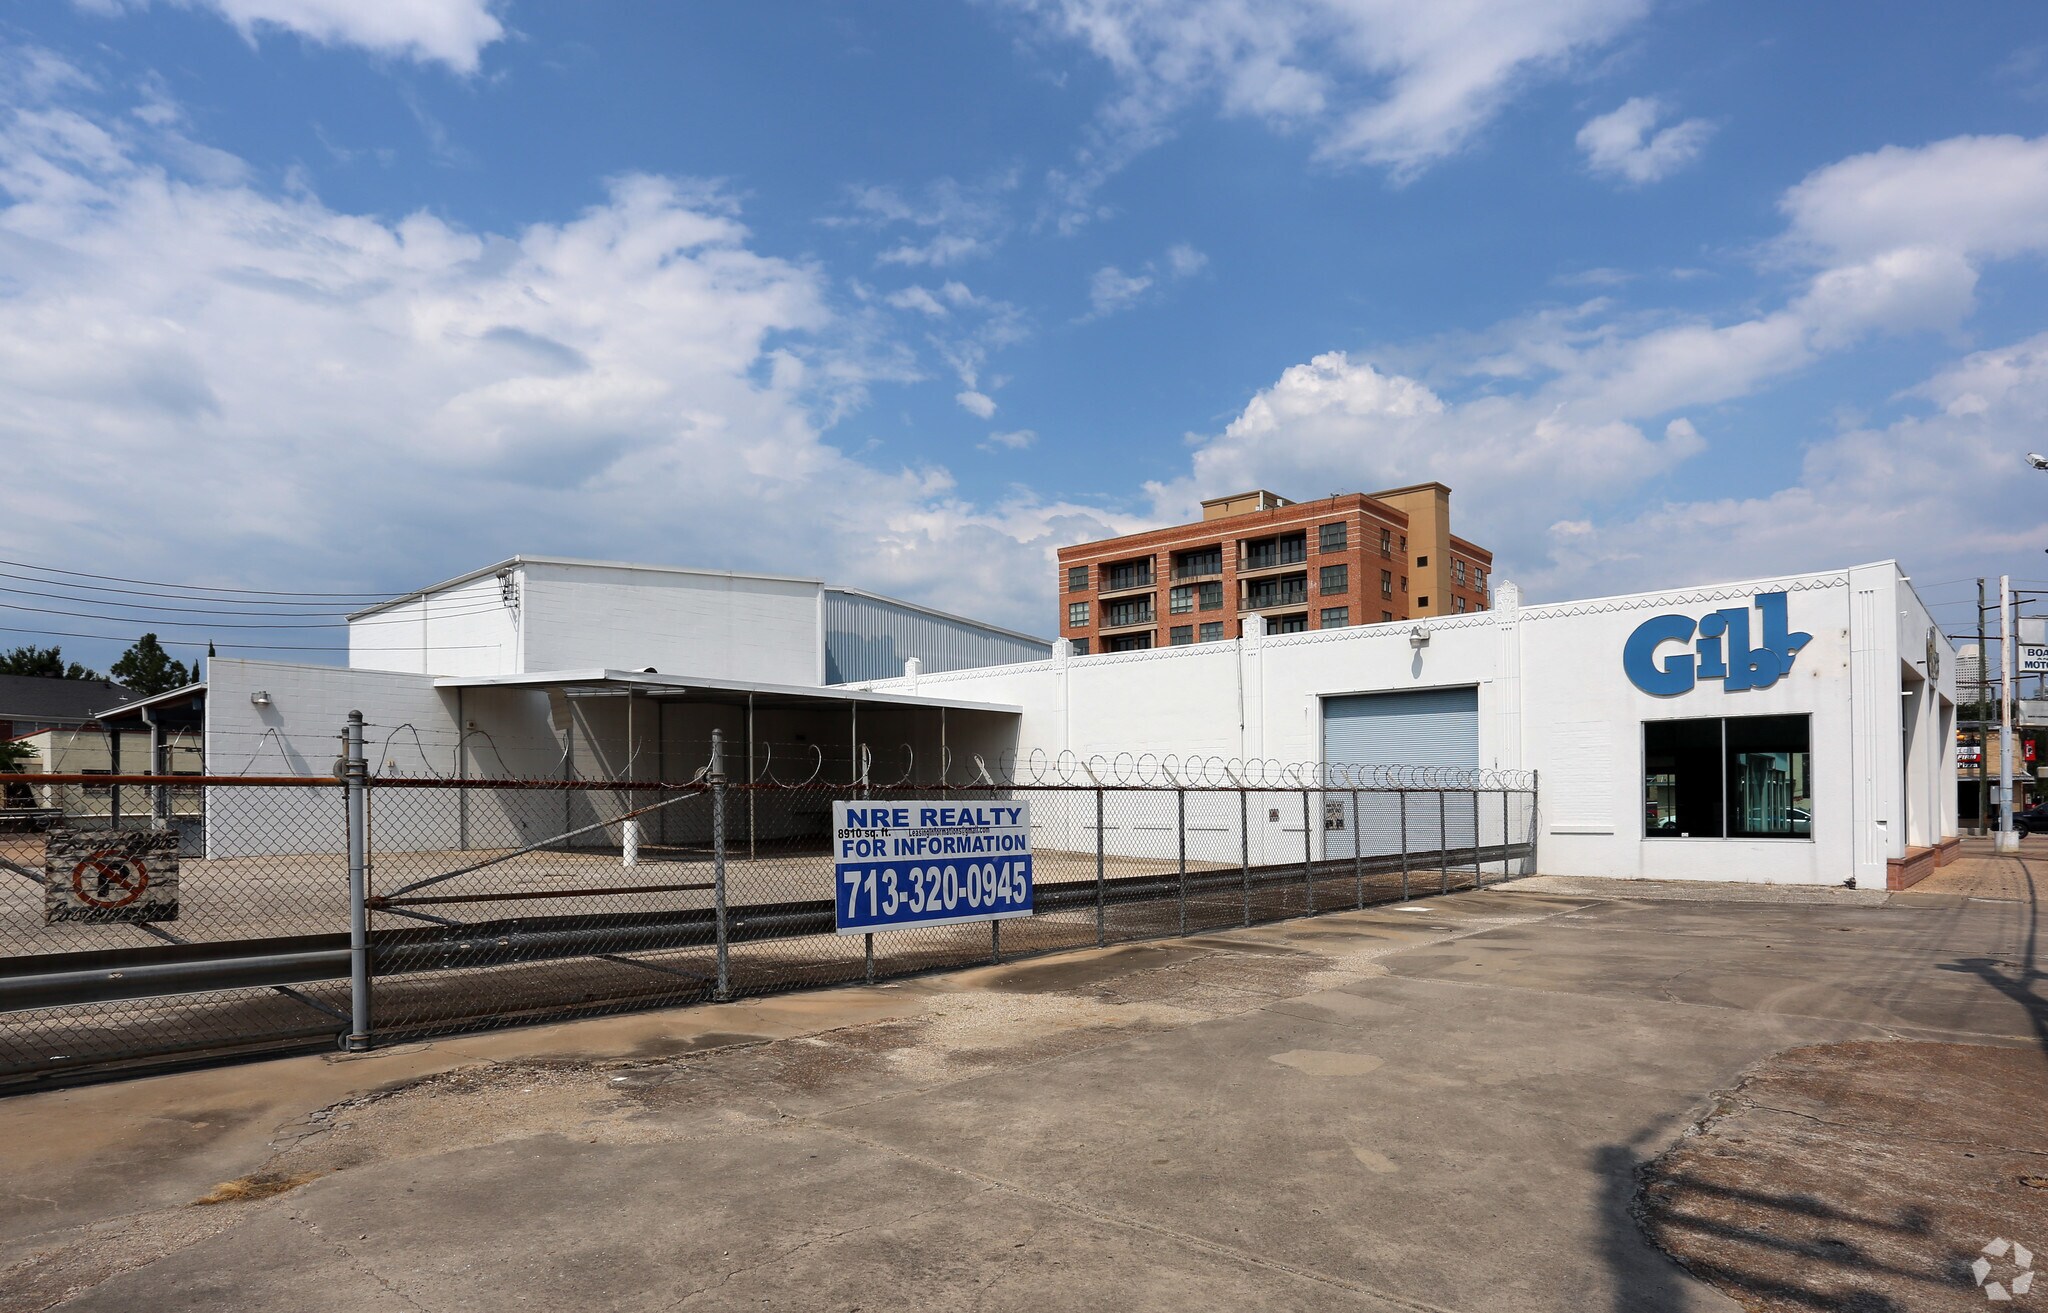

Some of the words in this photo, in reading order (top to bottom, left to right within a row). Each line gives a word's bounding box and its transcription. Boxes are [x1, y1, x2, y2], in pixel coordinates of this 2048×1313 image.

[847, 808, 909, 828] NRE
[920, 807, 1022, 827] REALTY
[838, 828, 862, 839] 8910
[864, 829, 879, 839] sq.
[881, 827, 892, 837] ft.
[842, 839, 887, 858] FOR
[894, 834, 1026, 856] INFORMATION
[843, 861, 1027, 918] 713-320-0945
